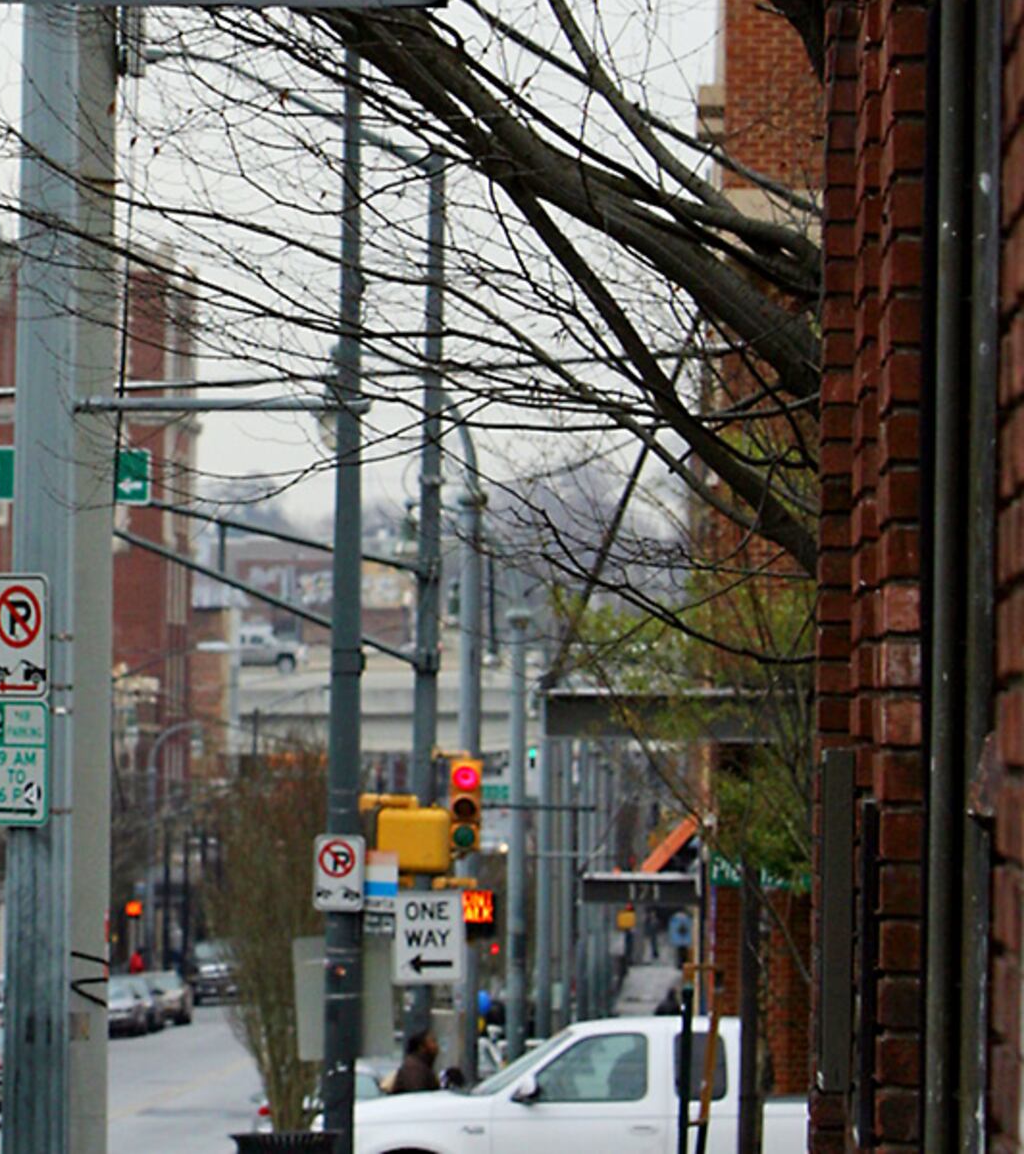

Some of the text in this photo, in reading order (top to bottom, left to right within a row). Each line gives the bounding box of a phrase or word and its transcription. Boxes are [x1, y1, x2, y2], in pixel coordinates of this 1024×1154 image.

[13, 751, 37, 766] AM
[7, 768, 26, 784] TO
[405, 901, 449, 921] ONE
[405, 929, 450, 947] WAY
